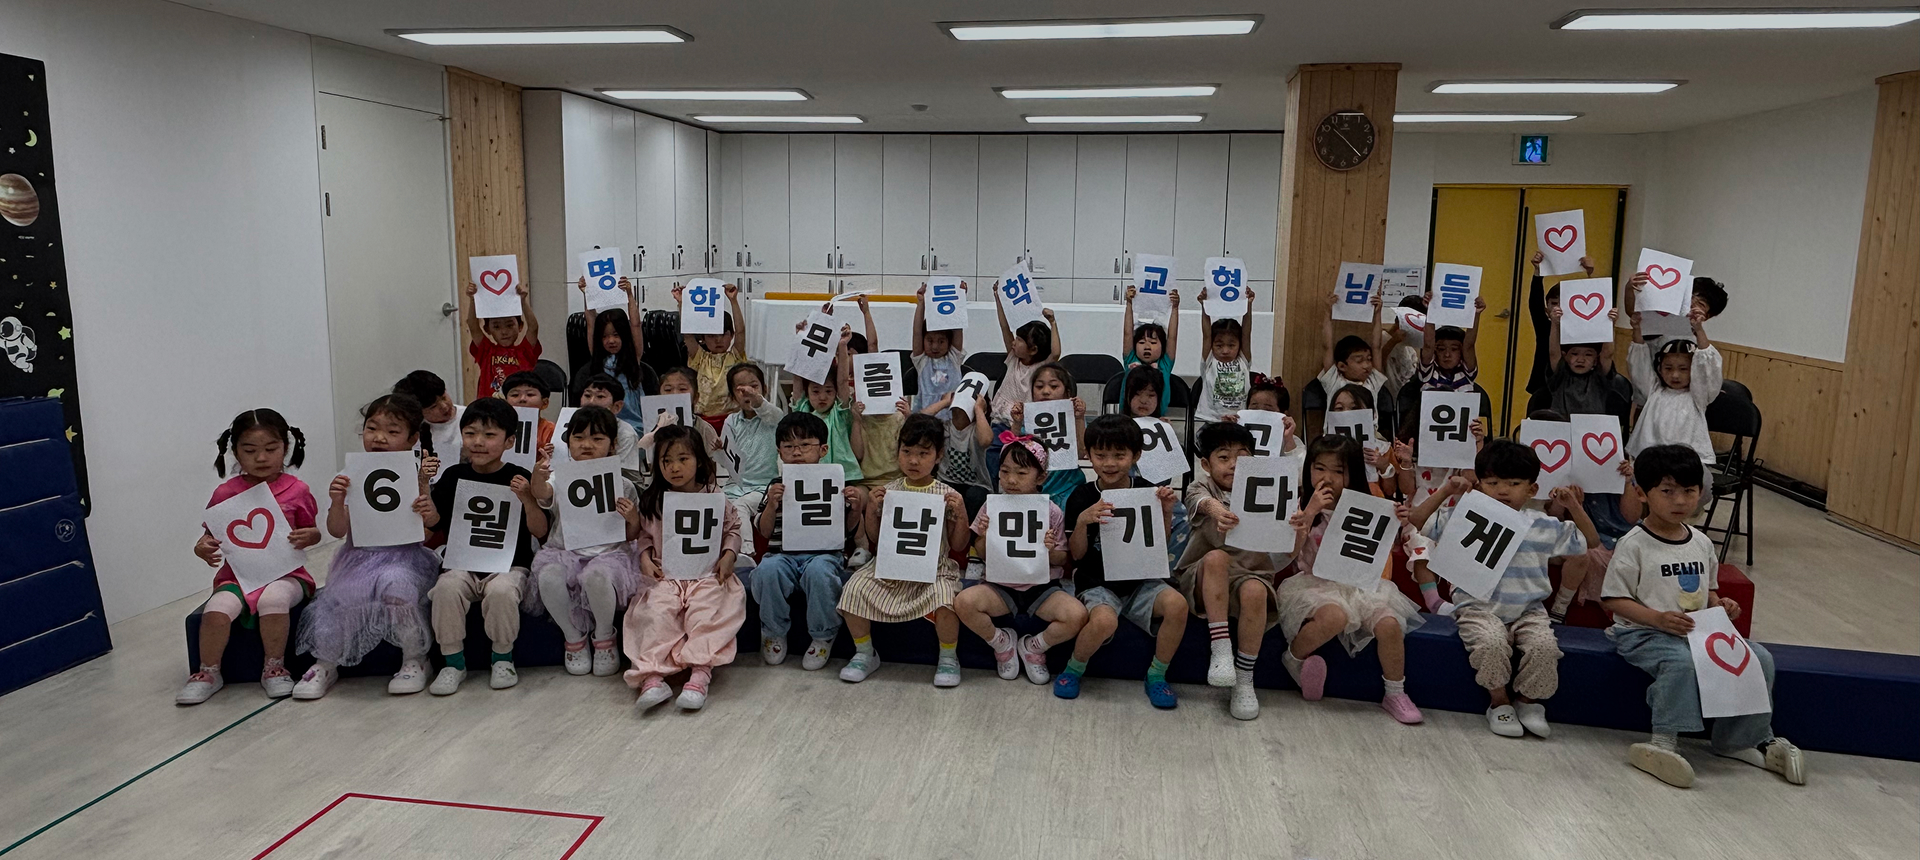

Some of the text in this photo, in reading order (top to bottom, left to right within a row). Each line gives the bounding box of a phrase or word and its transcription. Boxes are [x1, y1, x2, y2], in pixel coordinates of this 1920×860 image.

[1363, 124, 1371, 133] 2
[1366, 135, 1373, 144] 3
[588, 257, 616, 290] 명
[1002, 273, 1033, 306] 학
[1139, 265, 1168, 295] 교
[1211, 265, 1242, 302] 형
[1345, 273, 1375, 304] 님
[1440, 273, 1471, 309] 들
[689, 285, 721, 318] 학
[932, 284, 959, 315] 등
[801, 323, 832, 357] 무
[863, 362, 893, 397] 즐
[1034, 411, 1071, 452] 웠
[1142, 422, 1173, 452] 어
[1429, 404, 1470, 442] 워
[364, 469, 401, 512] 6
[567, 472, 616, 514] 에
[794, 478, 839, 526] 날
[1243, 475, 1293, 520] 다
[463, 495, 510, 550] 월
[674, 507, 718, 554] 만
[892, 506, 937, 556] 날
[998, 509, 1043, 558] 만
[1111, 505, 1154, 547] 기
[1340, 506, 1390, 564] 릴
[1460, 509, 1516, 570] 게
